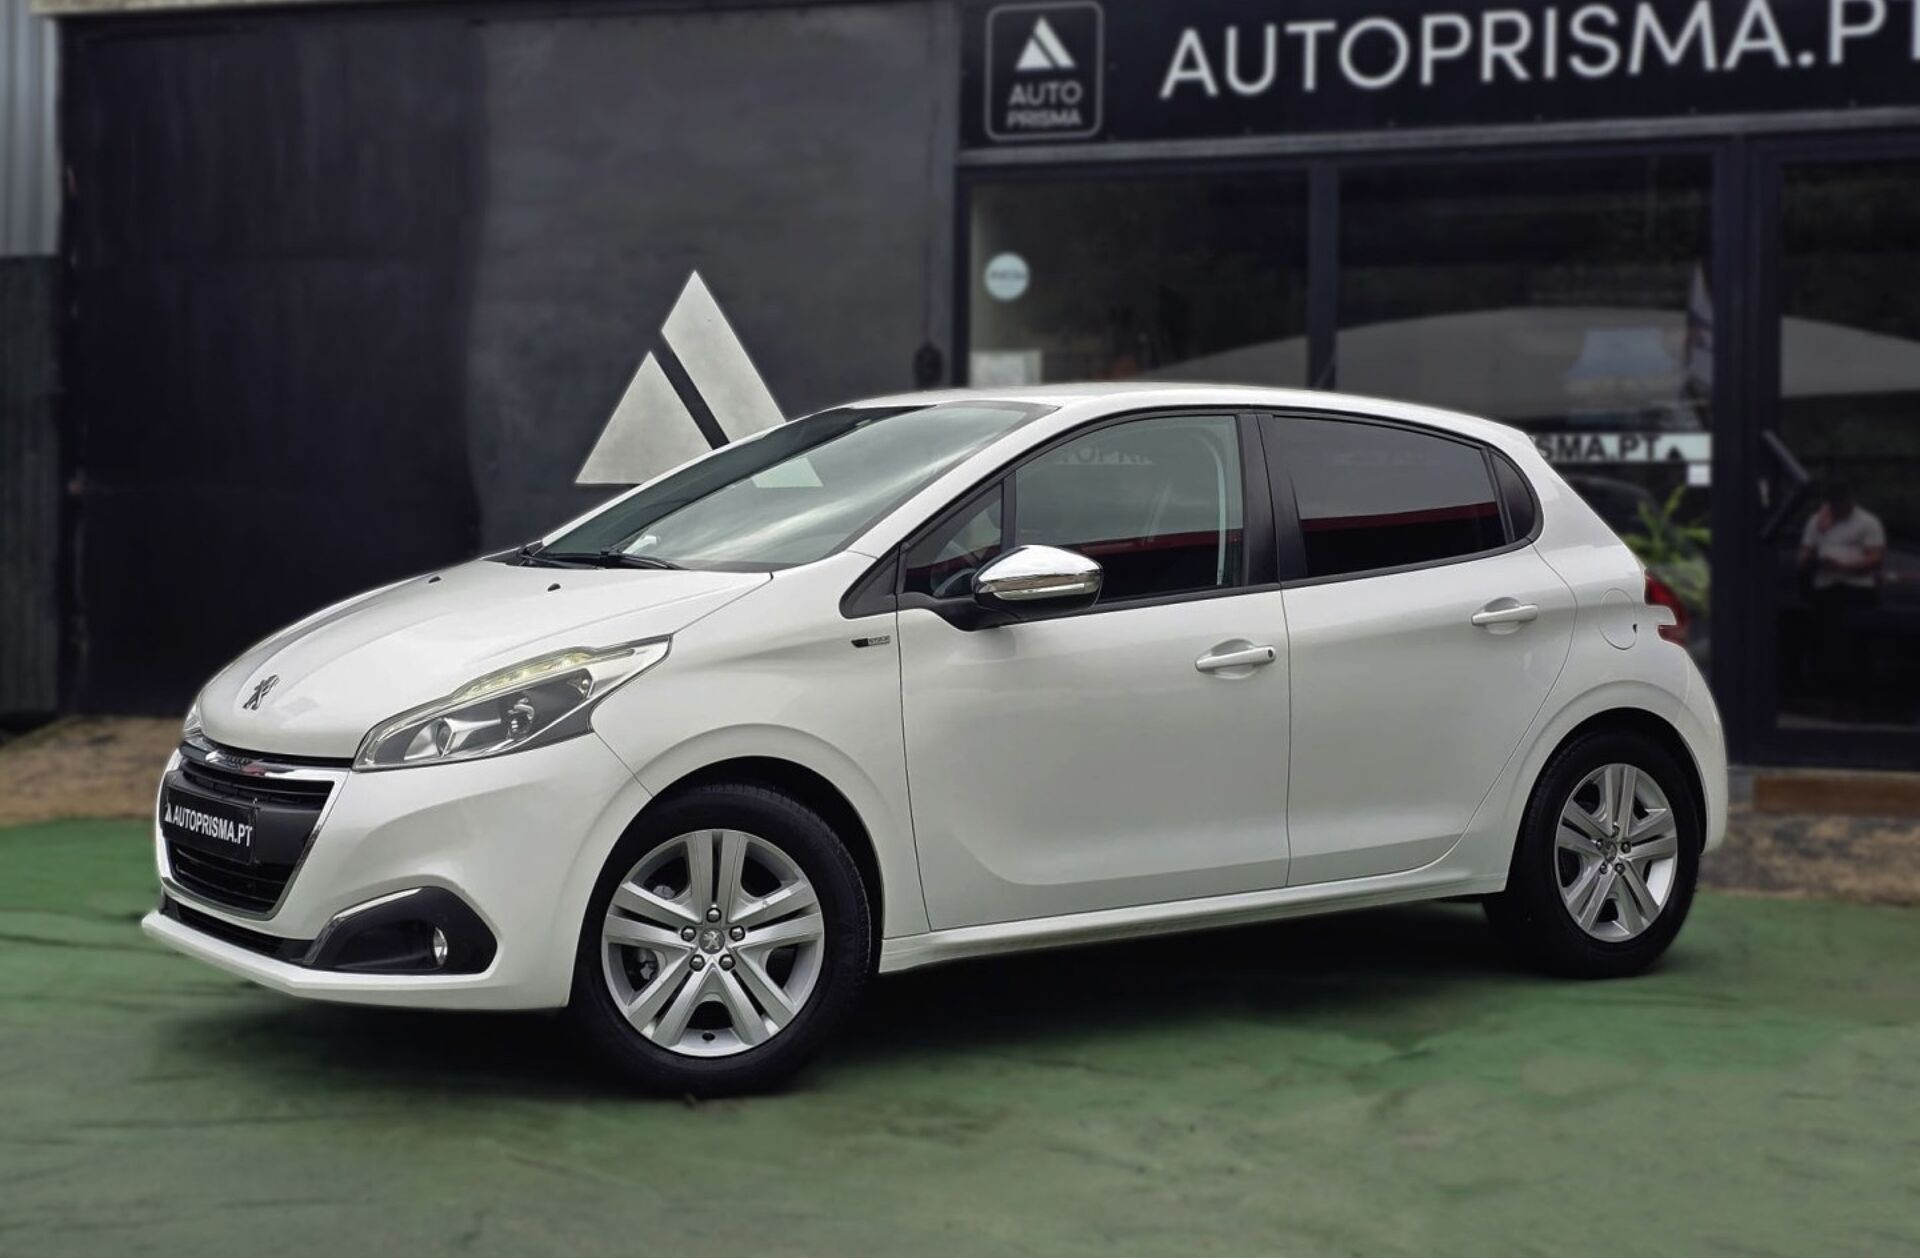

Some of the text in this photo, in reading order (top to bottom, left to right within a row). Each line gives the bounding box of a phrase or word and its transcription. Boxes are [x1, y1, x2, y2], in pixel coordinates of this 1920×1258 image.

[1009, 80, 1082, 106] AUTO
[1006, 108, 1083, 129] PRISMA
[172, 805, 252, 847] AUTOPRISMA.PT
